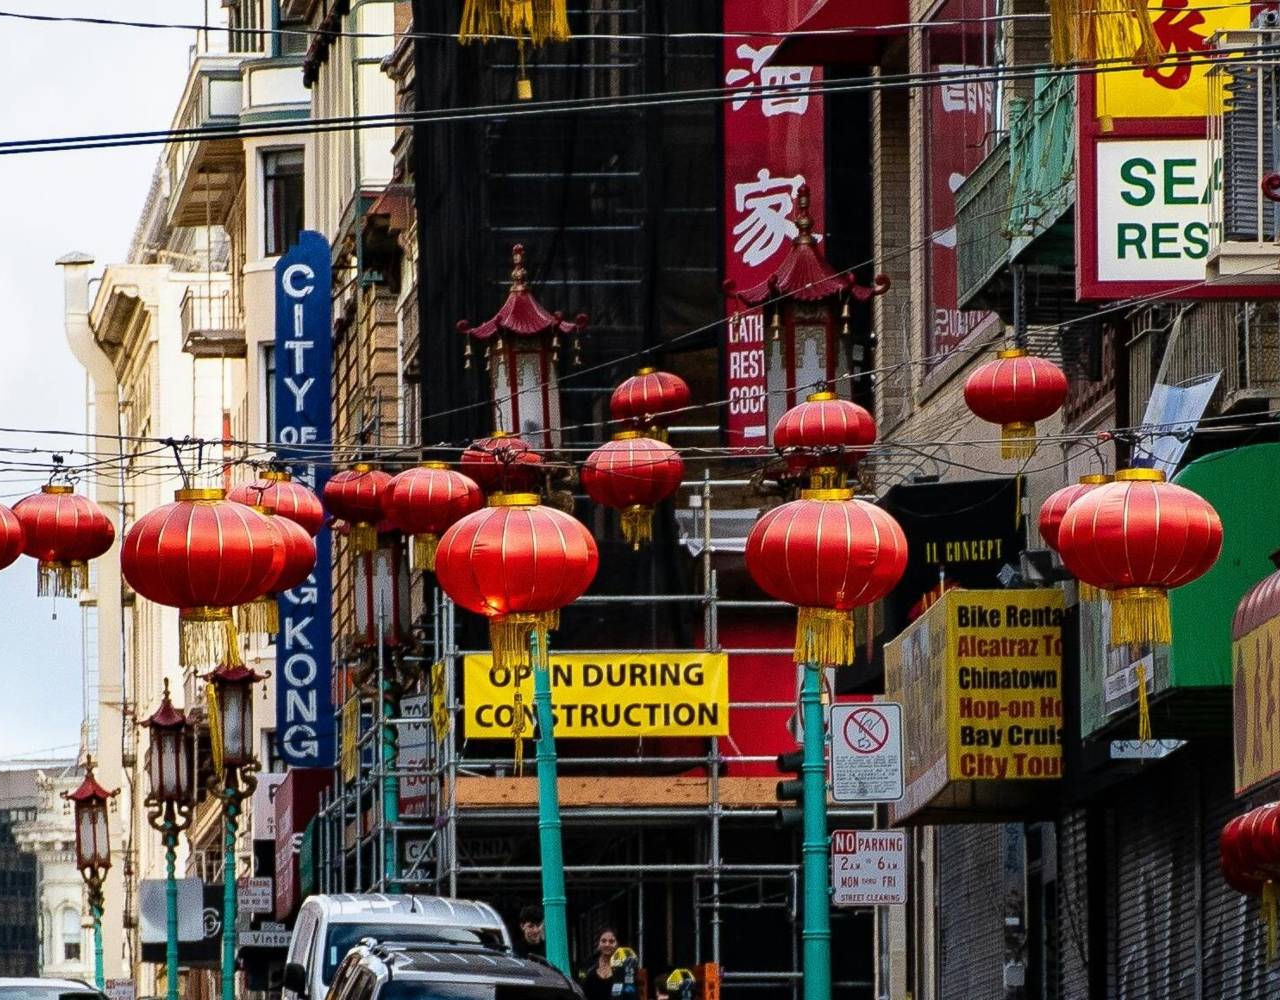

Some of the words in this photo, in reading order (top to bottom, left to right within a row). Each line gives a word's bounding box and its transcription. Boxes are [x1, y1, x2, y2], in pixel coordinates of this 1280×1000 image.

[282, 264, 315, 412] CITY
[279, 426, 317, 446] OF
[946, 538, 1003, 562] CONCEPT
[957, 605, 1001, 628] Bike
[958, 634, 1038, 658] Alcatraz
[283, 616, 318, 758] KONG
[489, 664, 572, 688] OPN
[583, 663, 704, 687] DURING
[958, 666, 1057, 690] Chinatown
[960, 697, 1035, 721] Hop-on
[961, 725, 1002, 747] Bay
[960, 753, 1007, 779] City
[835, 833, 855, 852] NO
[858, 838, 902, 852] PARKING
[841, 876, 859, 888] MON
[882, 876, 896, 887] FRI
